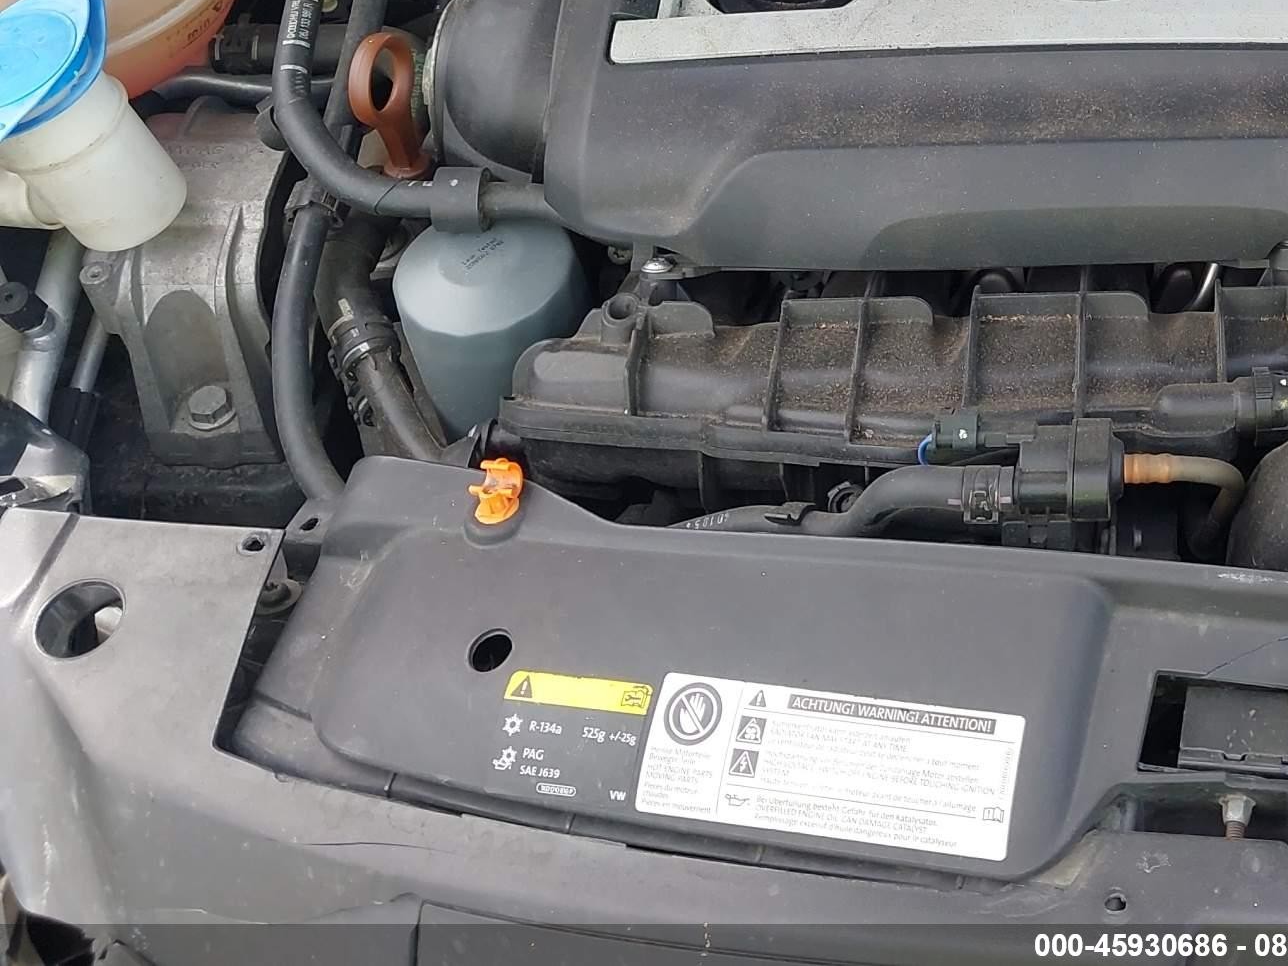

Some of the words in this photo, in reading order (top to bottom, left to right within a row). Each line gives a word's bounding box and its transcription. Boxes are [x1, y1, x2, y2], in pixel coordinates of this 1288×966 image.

[792, 698, 855, 715] ACHTUNG!
[858, 705, 919, 724] WARNING!
[921, 713, 992, 733] ATTENTION!
[529, 720, 562, 735] R-134a
[582, 726, 606, 743] 525g
[609, 730, 637, 747] +/-25g
[523, 747, 545, 761] PAG
[519, 765, 537, 777] SAE
[538, 767, 561, 779] J639
[610, 790, 627, 802] VW
